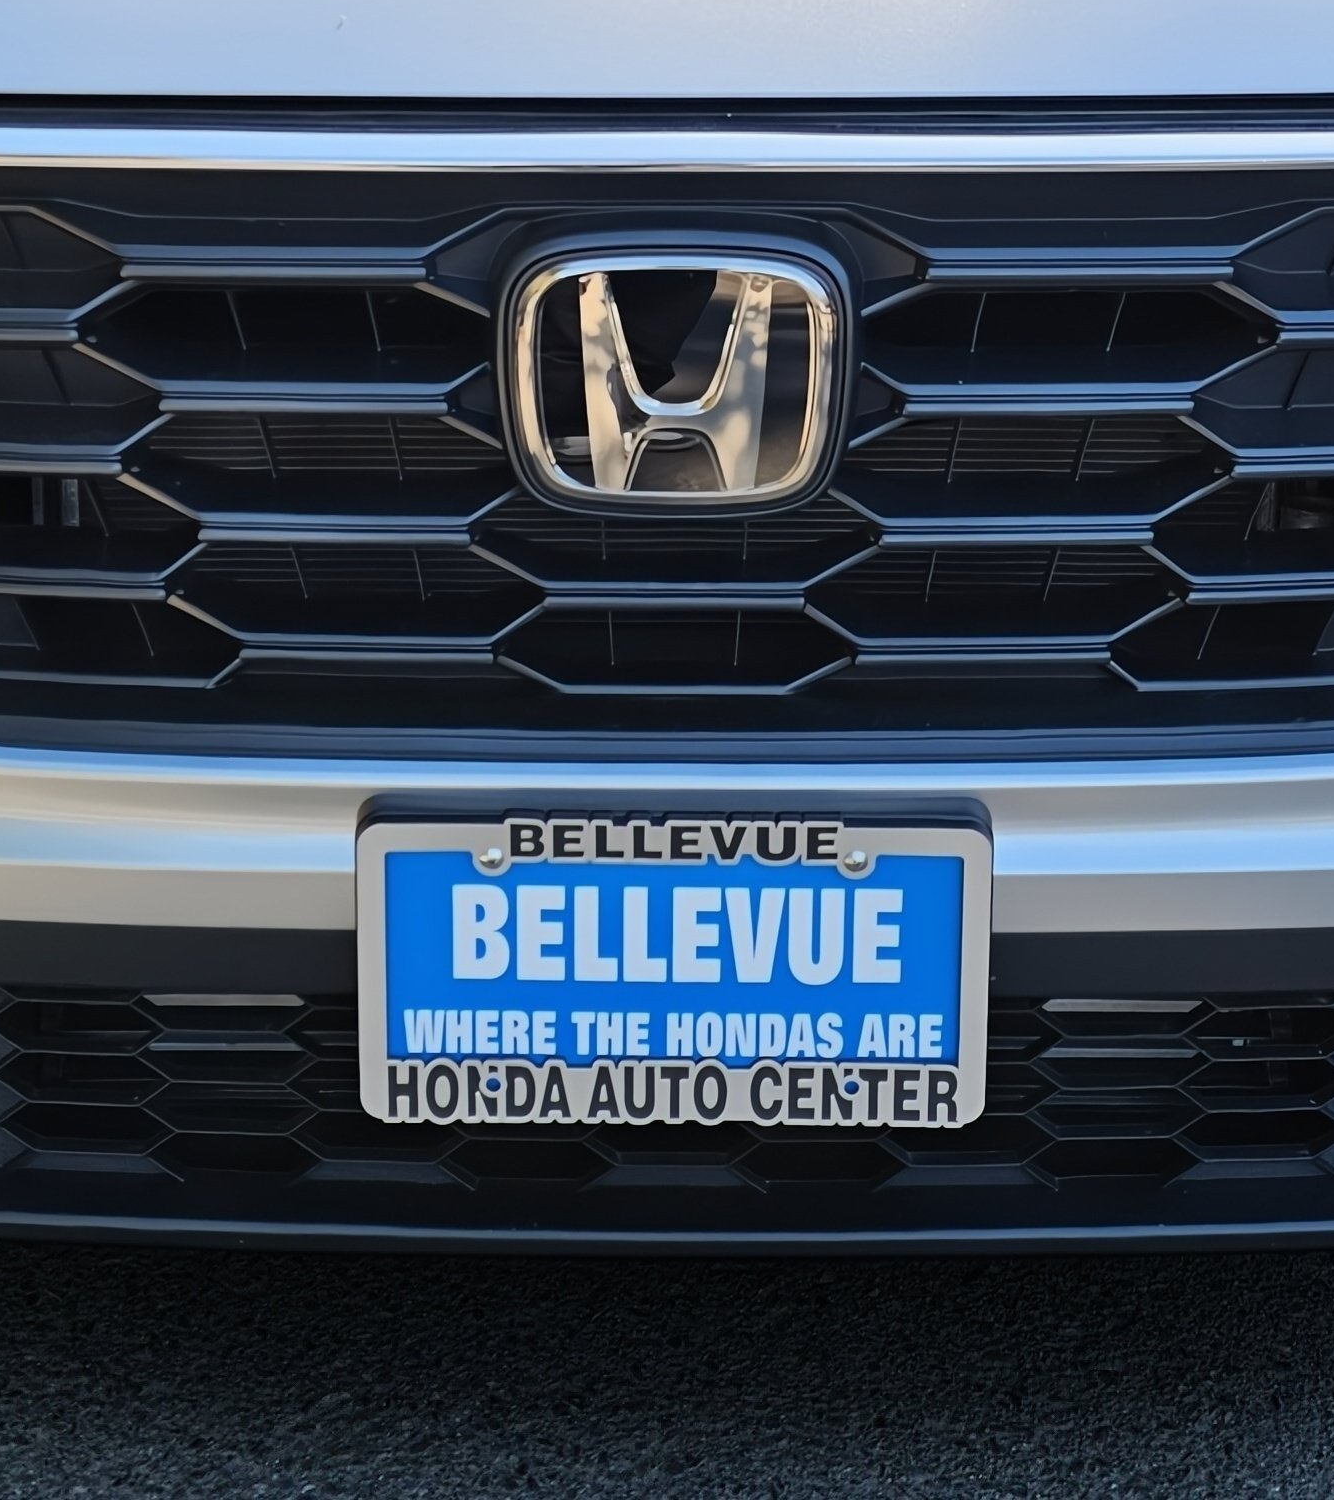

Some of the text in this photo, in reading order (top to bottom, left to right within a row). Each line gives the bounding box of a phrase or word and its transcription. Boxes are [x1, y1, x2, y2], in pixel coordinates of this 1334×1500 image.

[509, 823, 839, 861] BELLEVUE
[452, 884, 904, 985] BELLEVUE
[403, 1009, 944, 1059] WHERE THE HONDAS ARE
[387, 1065, 959, 1122] HONDA AUTO CENTER
